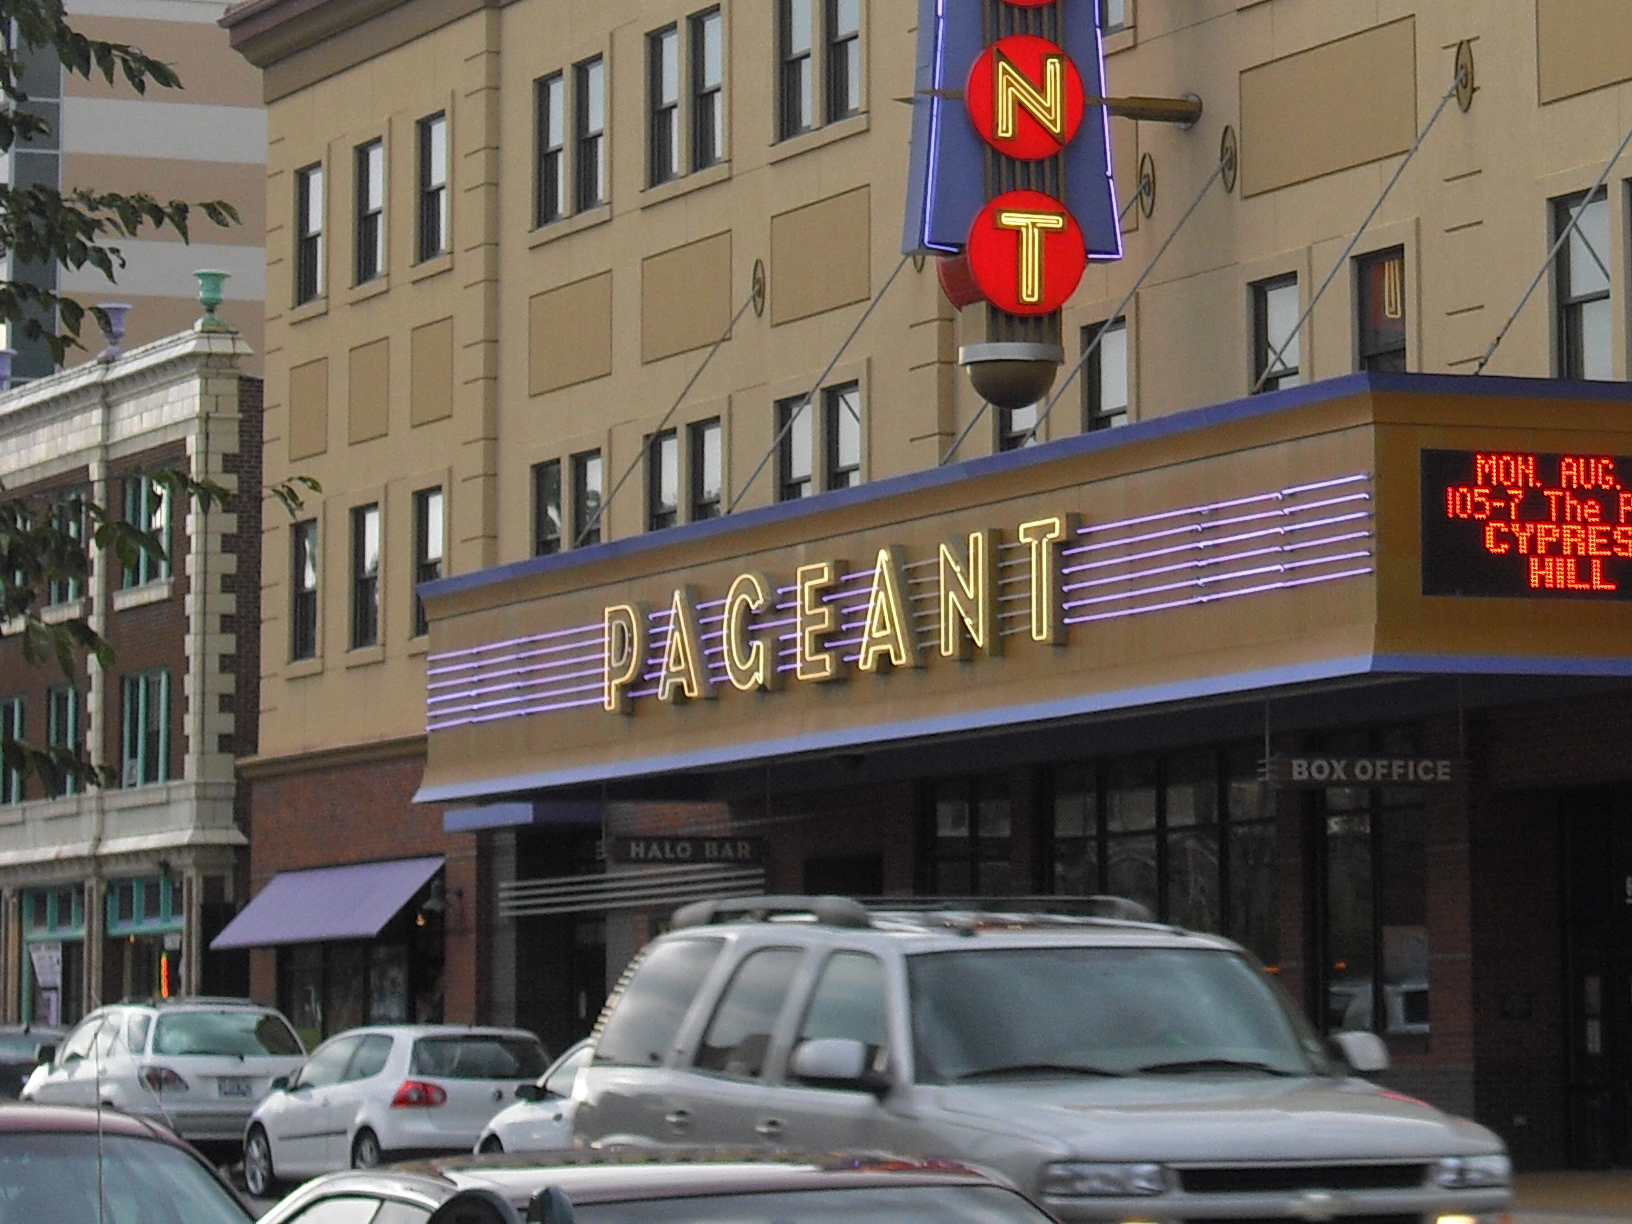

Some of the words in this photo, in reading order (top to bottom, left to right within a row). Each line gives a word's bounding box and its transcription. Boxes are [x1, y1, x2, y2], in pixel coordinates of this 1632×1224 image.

[1474, 453, 1542, 488] MON.
[1560, 456, 1622, 491] AUG.
[1543, 490, 1600, 523] The
[1529, 555, 1618, 591] HILL
[603, 516, 1070, 713] PAGEANT
[1291, 759, 1348, 781] BOX
[1354, 759, 1452, 781] OFFICE
[629, 840, 692, 859] HALO
[704, 840, 752, 859] BAR
